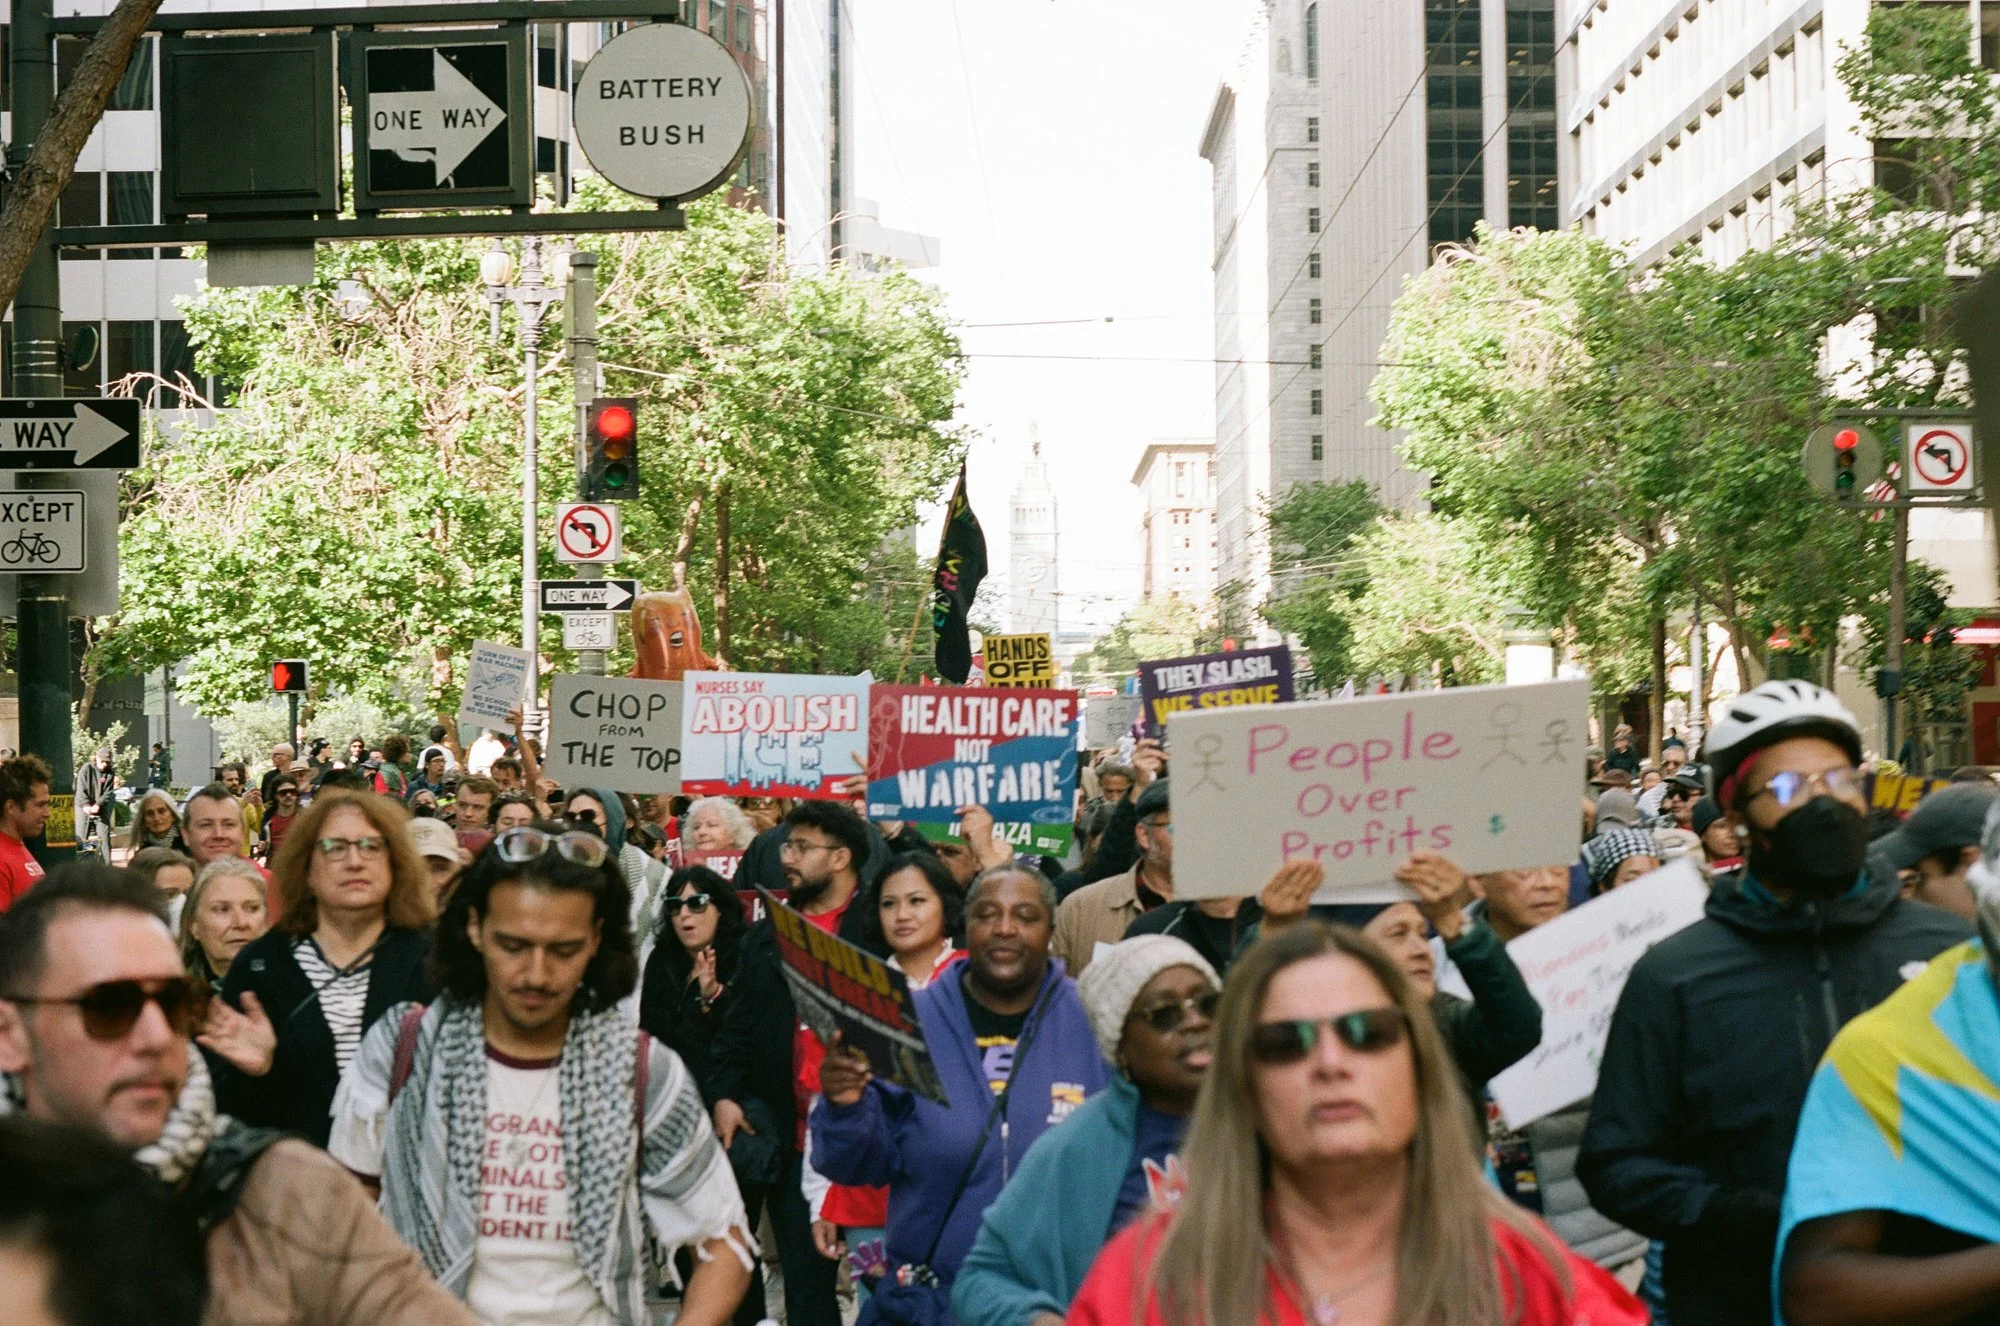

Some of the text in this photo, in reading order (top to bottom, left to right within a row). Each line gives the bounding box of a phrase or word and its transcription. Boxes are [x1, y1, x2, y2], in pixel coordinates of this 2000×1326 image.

[600, 77, 722, 100] BATTERY
[374, 107, 491, 131] ONE WAY
[620, 125, 705, 146] BUSH
[14, 422, 74, 448] WAY
[0, 502, 74, 523] XCEPT
[550, 590, 607, 602] ONE WAY
[569, 617, 608, 627] EXCEPT
[987, 636, 1047, 661] HANDS
[989, 660, 1049, 678] OFF
[1153, 655, 1279, 690] THEY SLASH.
[695, 680, 765, 694] NURSES SAY
[570, 689, 667, 721] CHOP
[692, 694, 858, 734] ABOLISH
[901, 695, 998, 736] HEALTH
[1002, 698, 1070, 737] CARE
[599, 724, 644, 738] FROM
[561, 741, 681, 773] THE TOP
[954, 738, 992, 763] NOT
[1246, 711, 1463, 783] People
[724, 730, 824, 792] ICE
[898, 759, 1062, 809] WARFARE
[1296, 783, 1418, 818] Over
[991, 822, 1032, 846] AZA
[1281, 815, 1453, 862] Profits
[486, 1113, 562, 1138] GRAN
[528, 1143, 562, 1165] OT
[504, 1193, 548, 1215] THE
[481, 1218, 547, 1240] DENT
